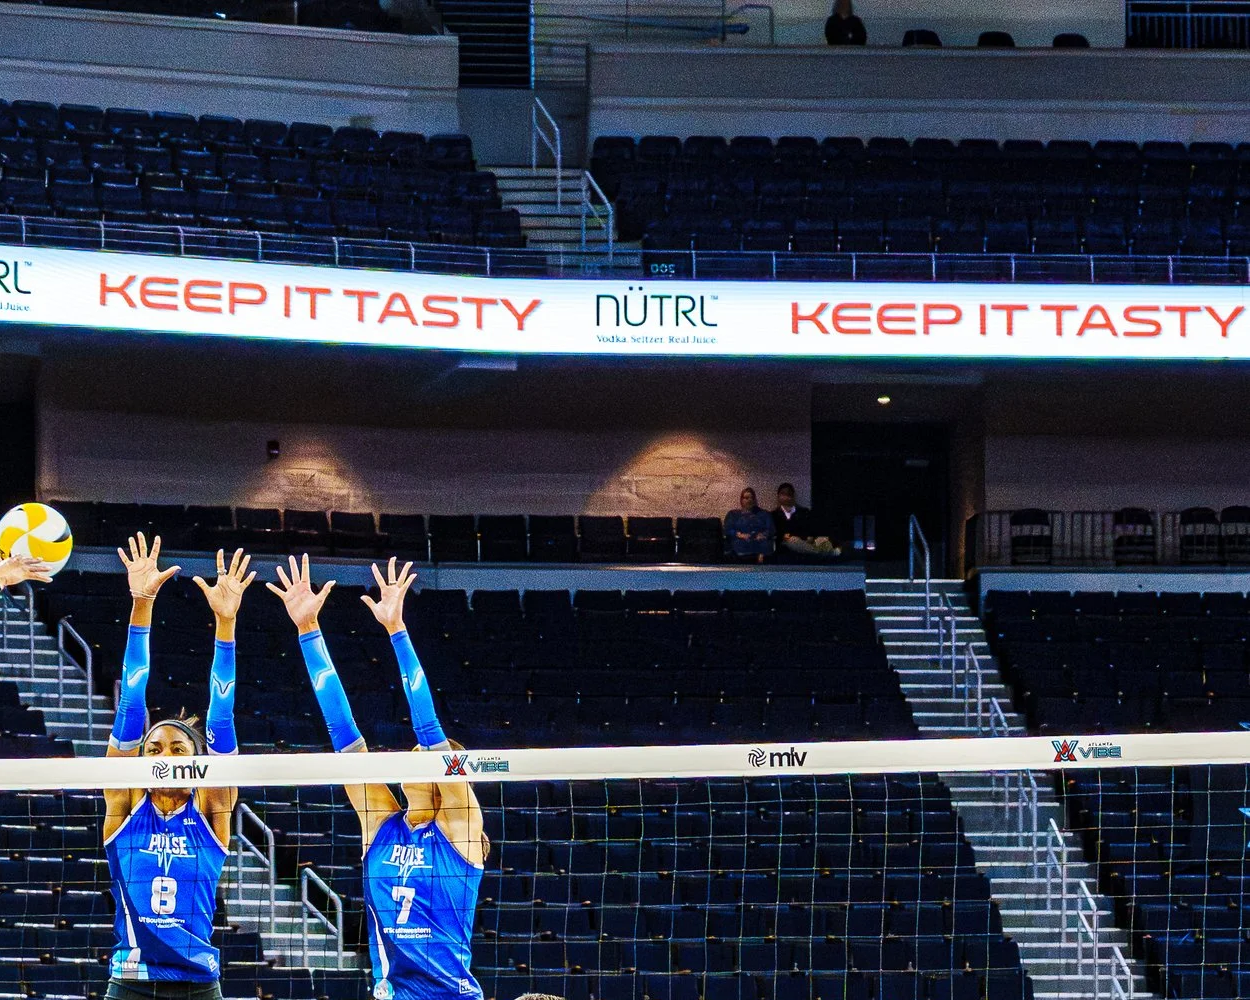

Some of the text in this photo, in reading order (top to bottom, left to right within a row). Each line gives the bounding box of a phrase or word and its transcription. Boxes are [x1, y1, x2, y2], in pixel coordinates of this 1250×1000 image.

[100, 273, 540, 330] KEEP IT TASTY
[792, 303, 1245, 337] KEEP IT TASTY
[467, 760, 510, 773] VIBE
[1078, 746, 1122, 759] VIBE
[148, 834, 188, 855] PULSE
[150, 876, 178, 915] 8
[391, 886, 416, 924] 7
